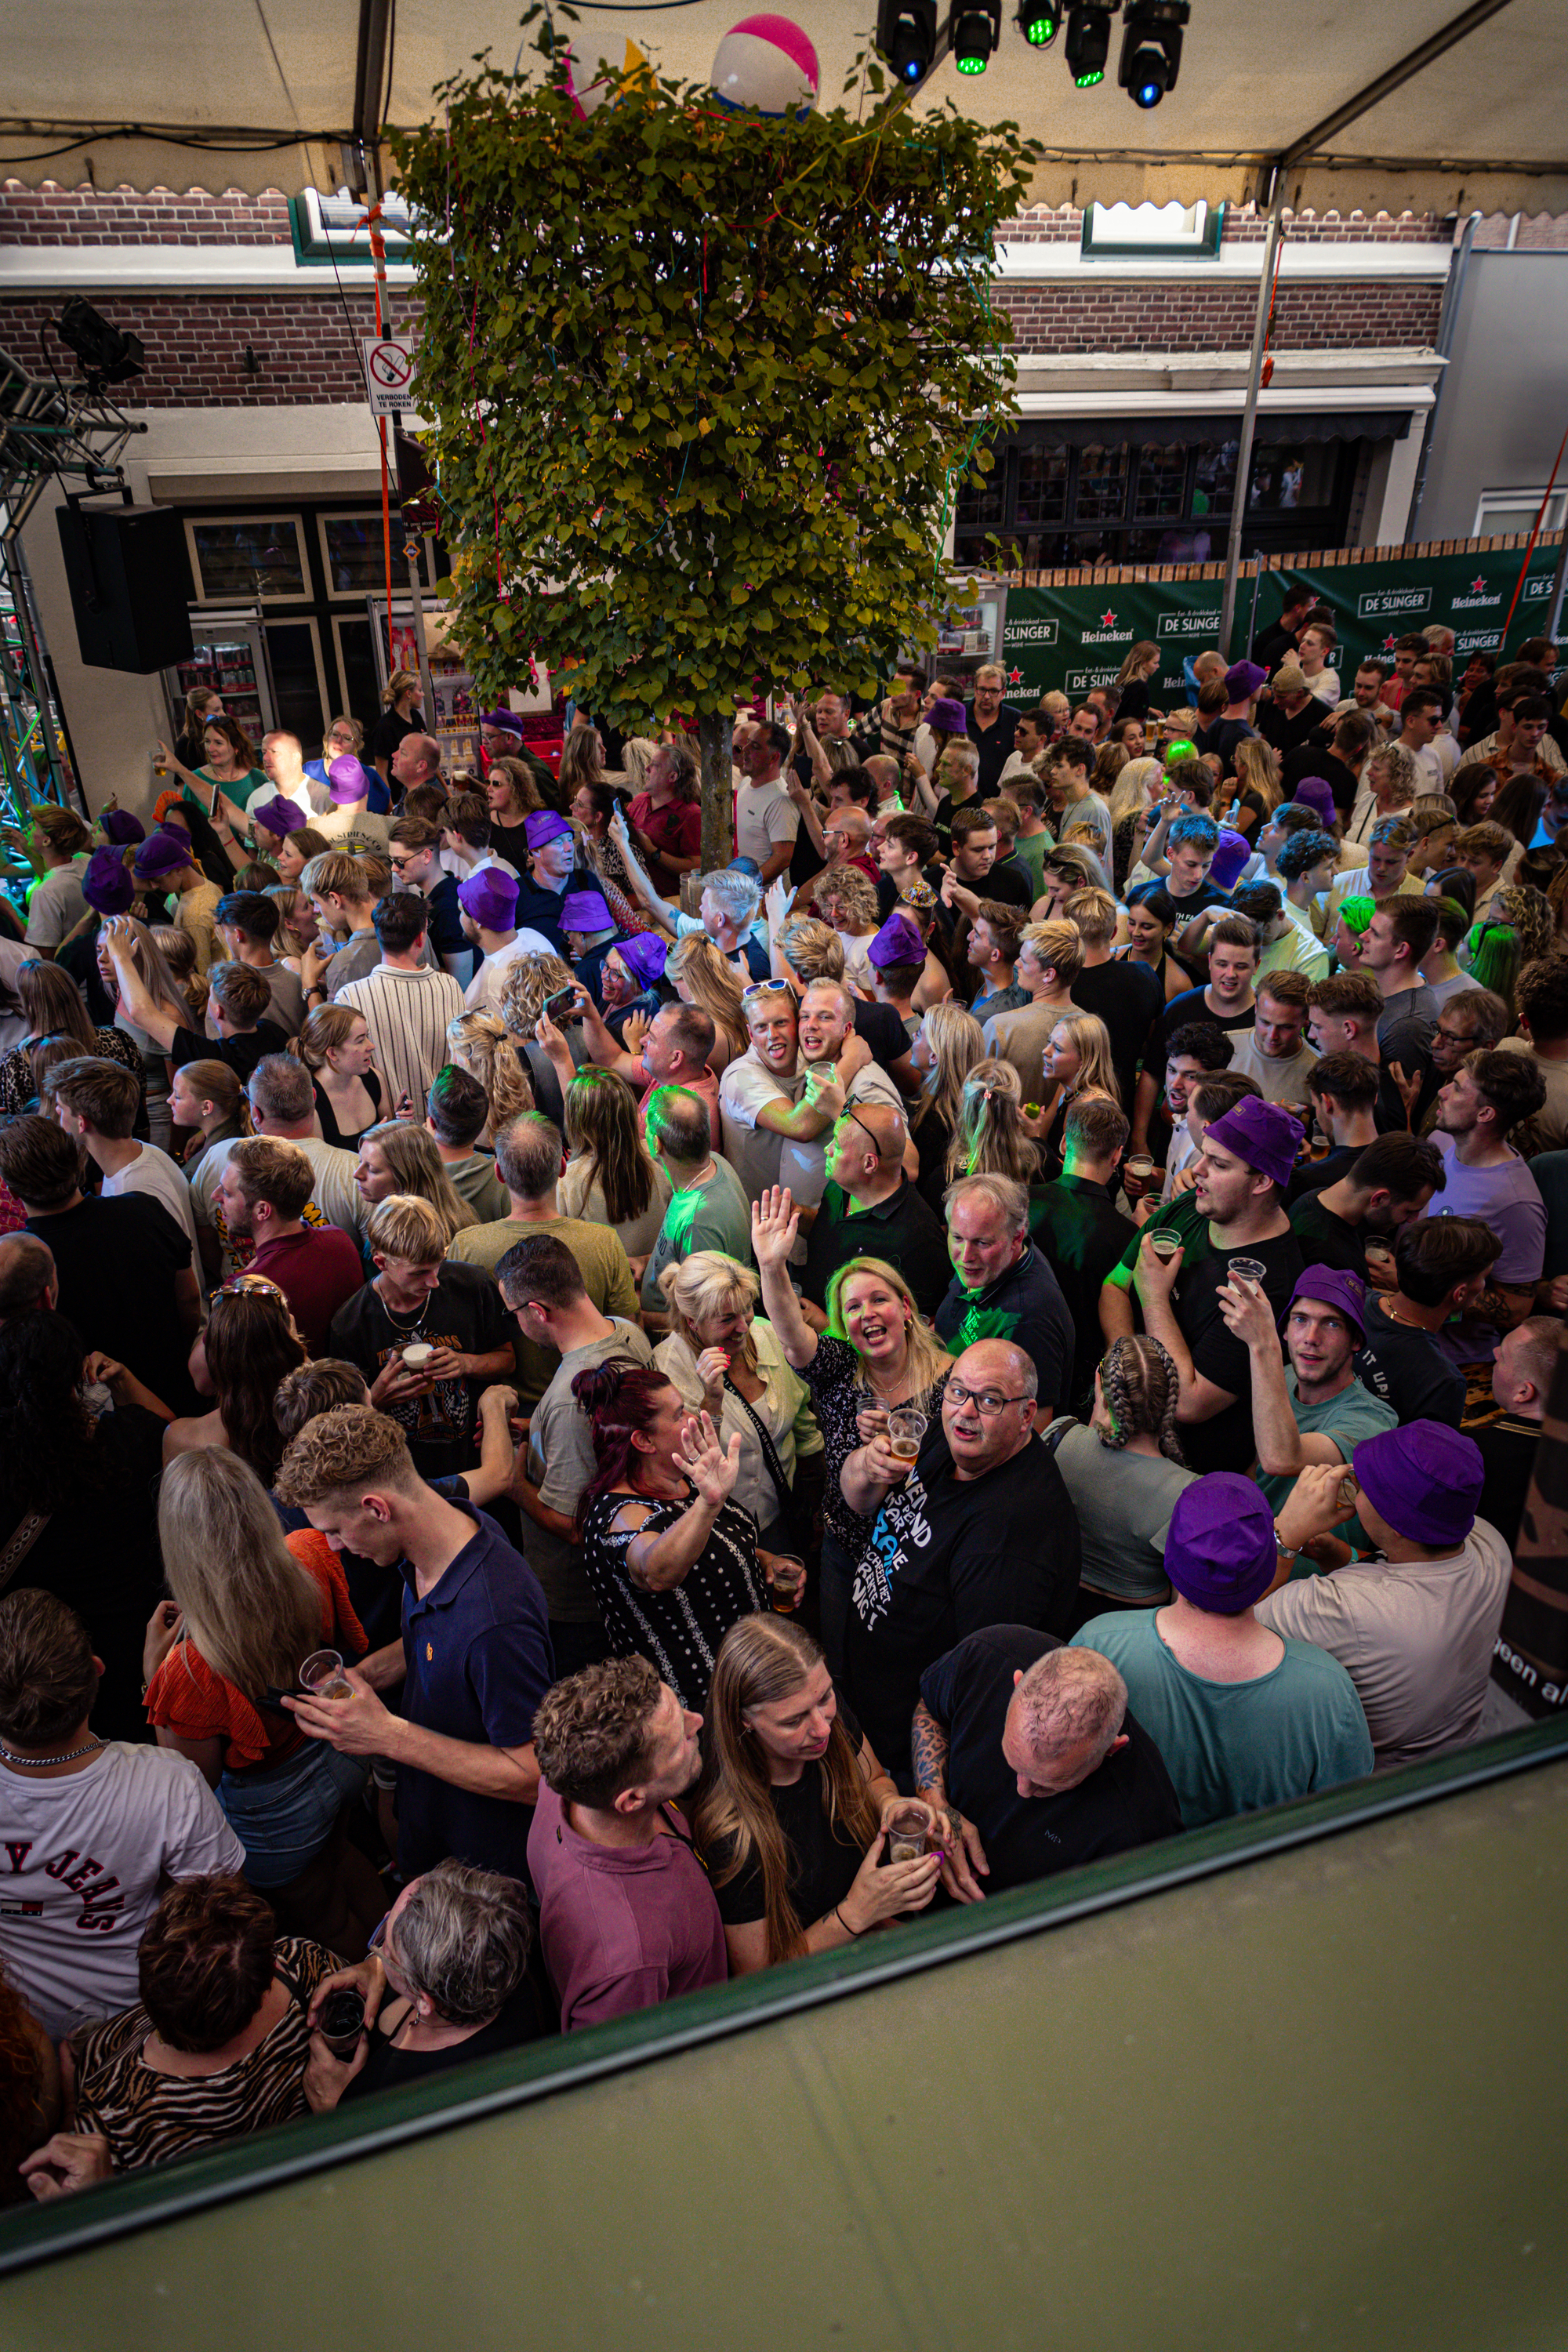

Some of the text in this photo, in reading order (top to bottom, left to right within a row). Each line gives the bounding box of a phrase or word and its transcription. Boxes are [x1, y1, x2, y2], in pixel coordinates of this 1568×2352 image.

[1530, 582, 1544, 595] DE
[1365, 593, 1425, 612] DE SLINGER
[1451, 593, 1501, 609] Heineken
[1165, 616, 1220, 632] DE SLINGE
[1004, 626, 1051, 641] SLINGER
[1081, 629, 1134, 644] Heineken
[1457, 634, 1500, 651] SLINGER
[1329, 652, 1337, 664] R
[1073, 675, 1087, 688] DE
[1362, 1349, 1377, 1366] IT
[1373, 1371, 1390, 1399] UP!
[761, 1433, 768, 1443] OR
[765, 1443, 775, 1463] SIMPLE
[775, 1465, 785, 1484] NEVER
[879, 1584, 891, 1605] HET
[45, 1849, 125, 1932] JEANS
